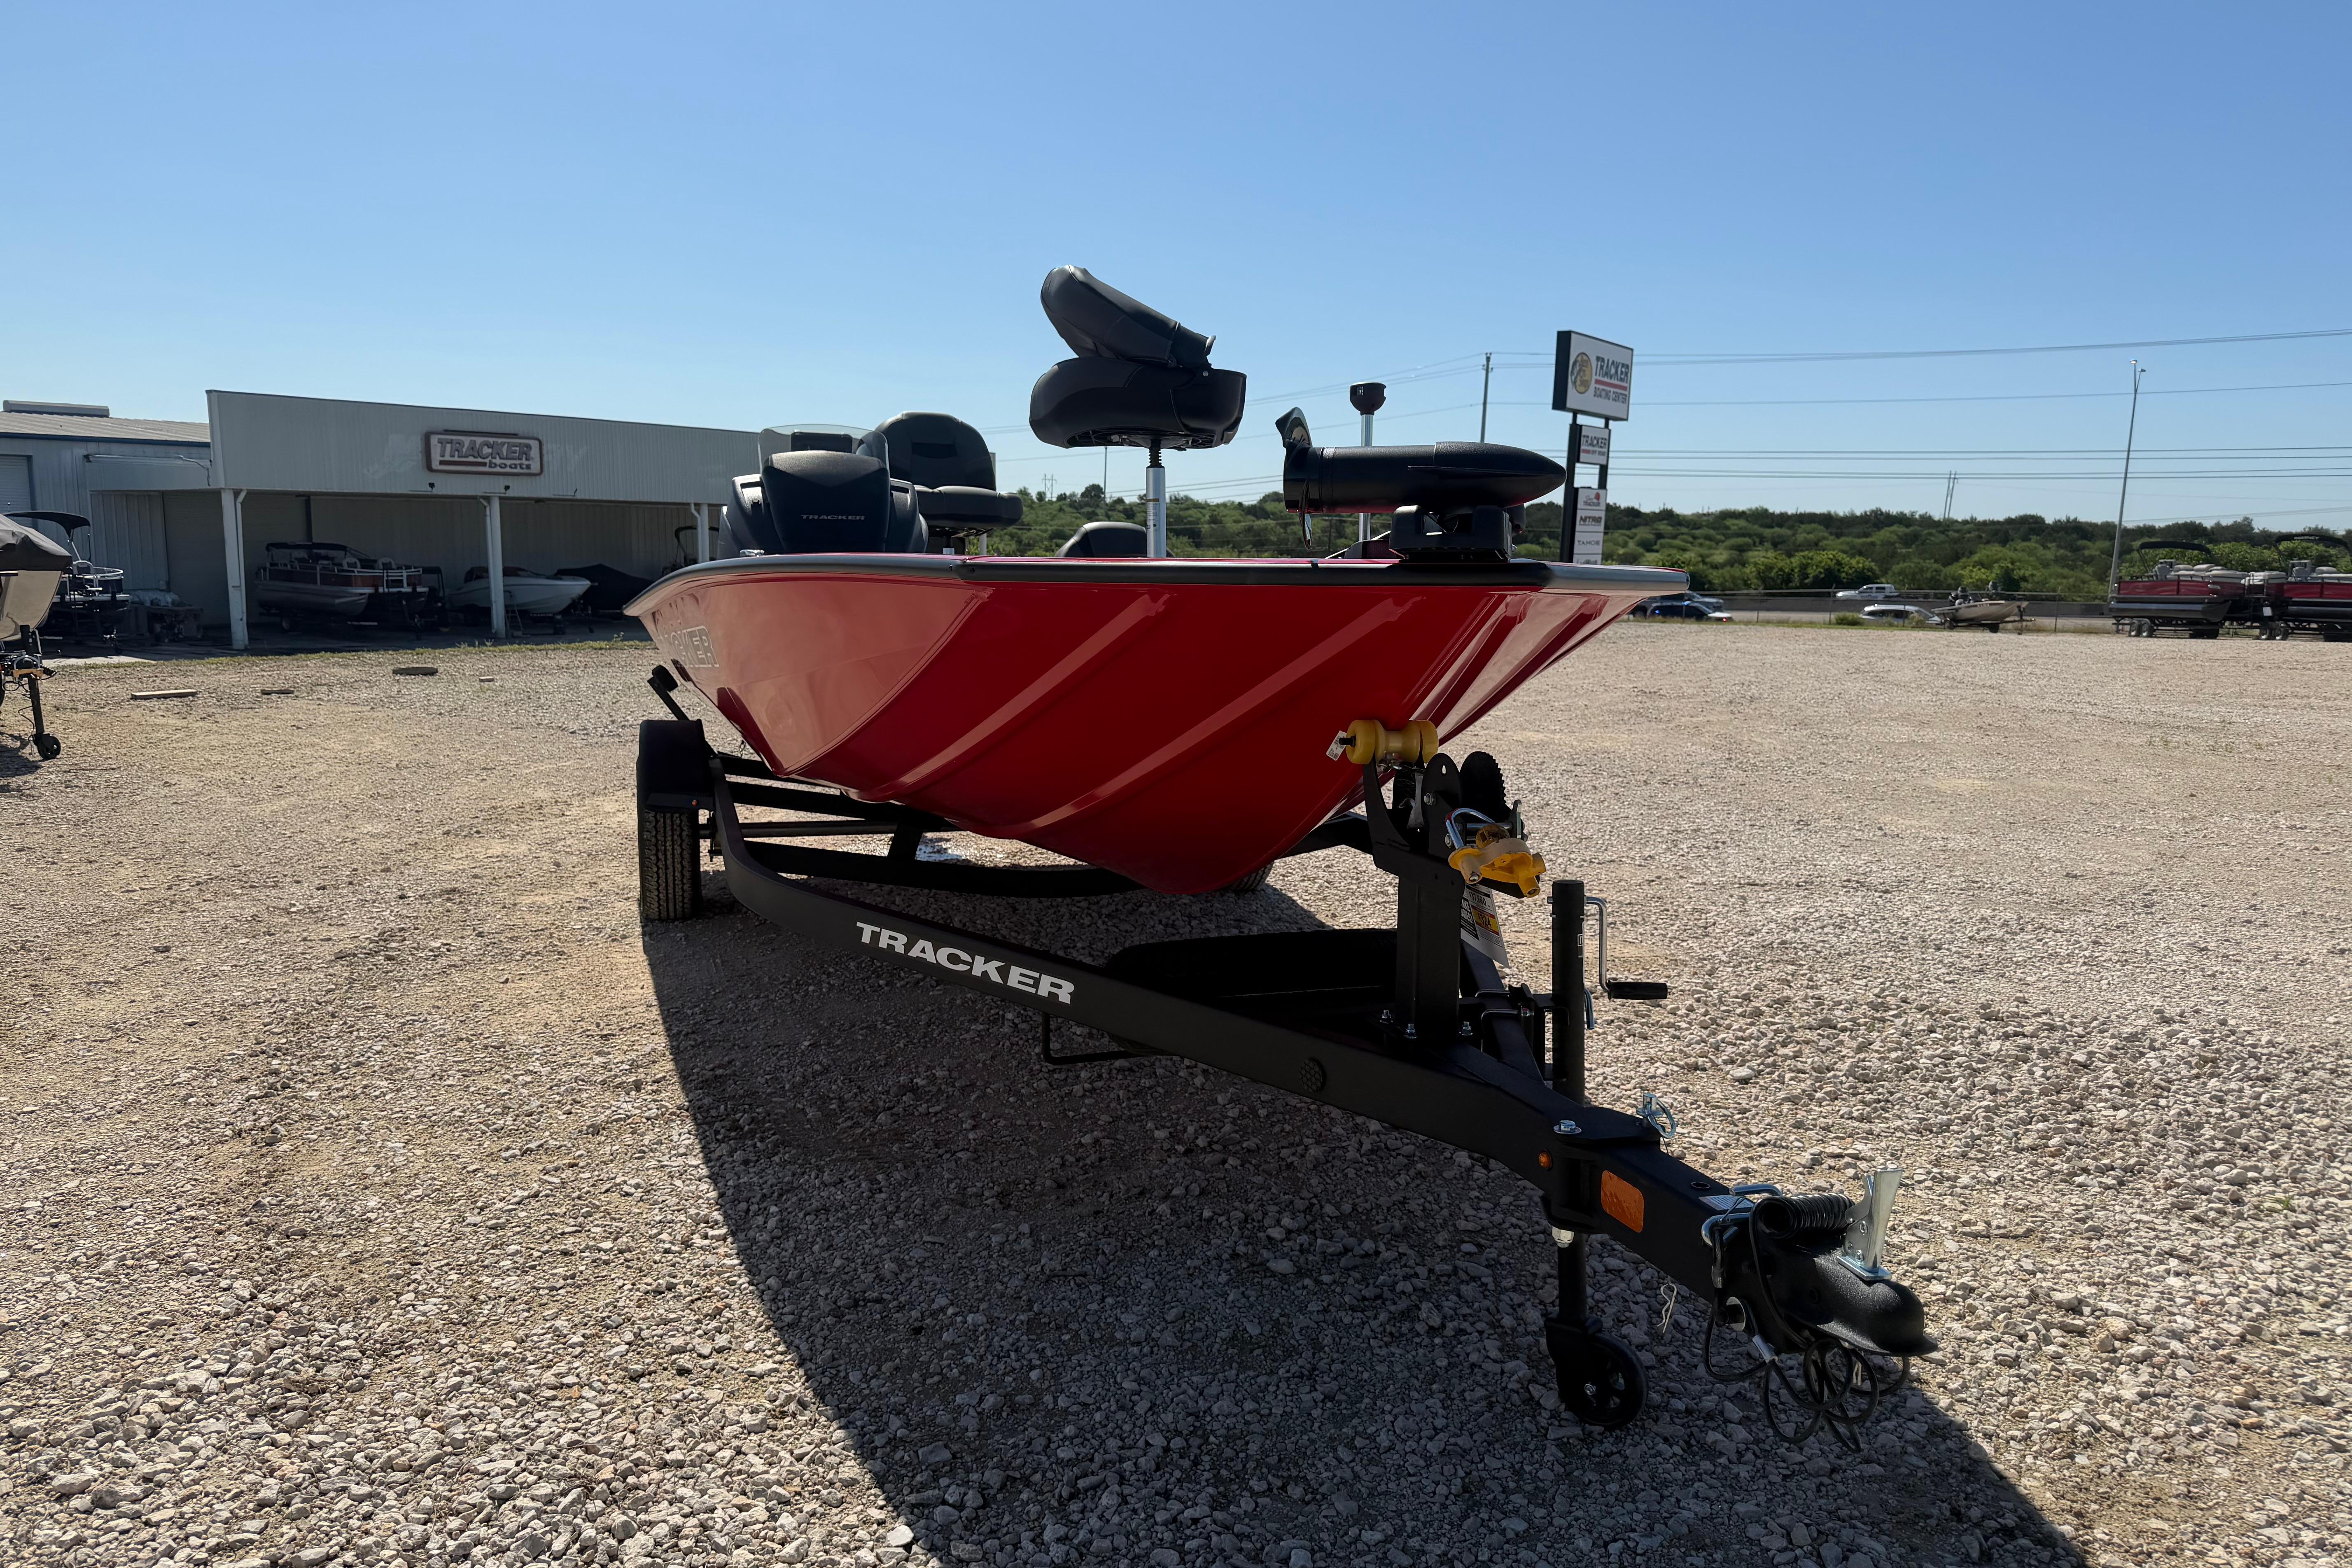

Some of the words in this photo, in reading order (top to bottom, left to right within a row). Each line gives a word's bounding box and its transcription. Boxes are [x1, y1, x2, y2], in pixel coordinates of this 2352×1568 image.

[1595, 356, 1629, 384] TRACKER
[1594, 387, 1611, 401] BOATING
[1612, 392, 1627, 404] CENTER
[437, 438, 532, 461] TRACKER
[1582, 435, 1607, 449] TRACKER
[488, 460, 531, 470] boats
[856, 922, 1075, 1005] TRACKER
